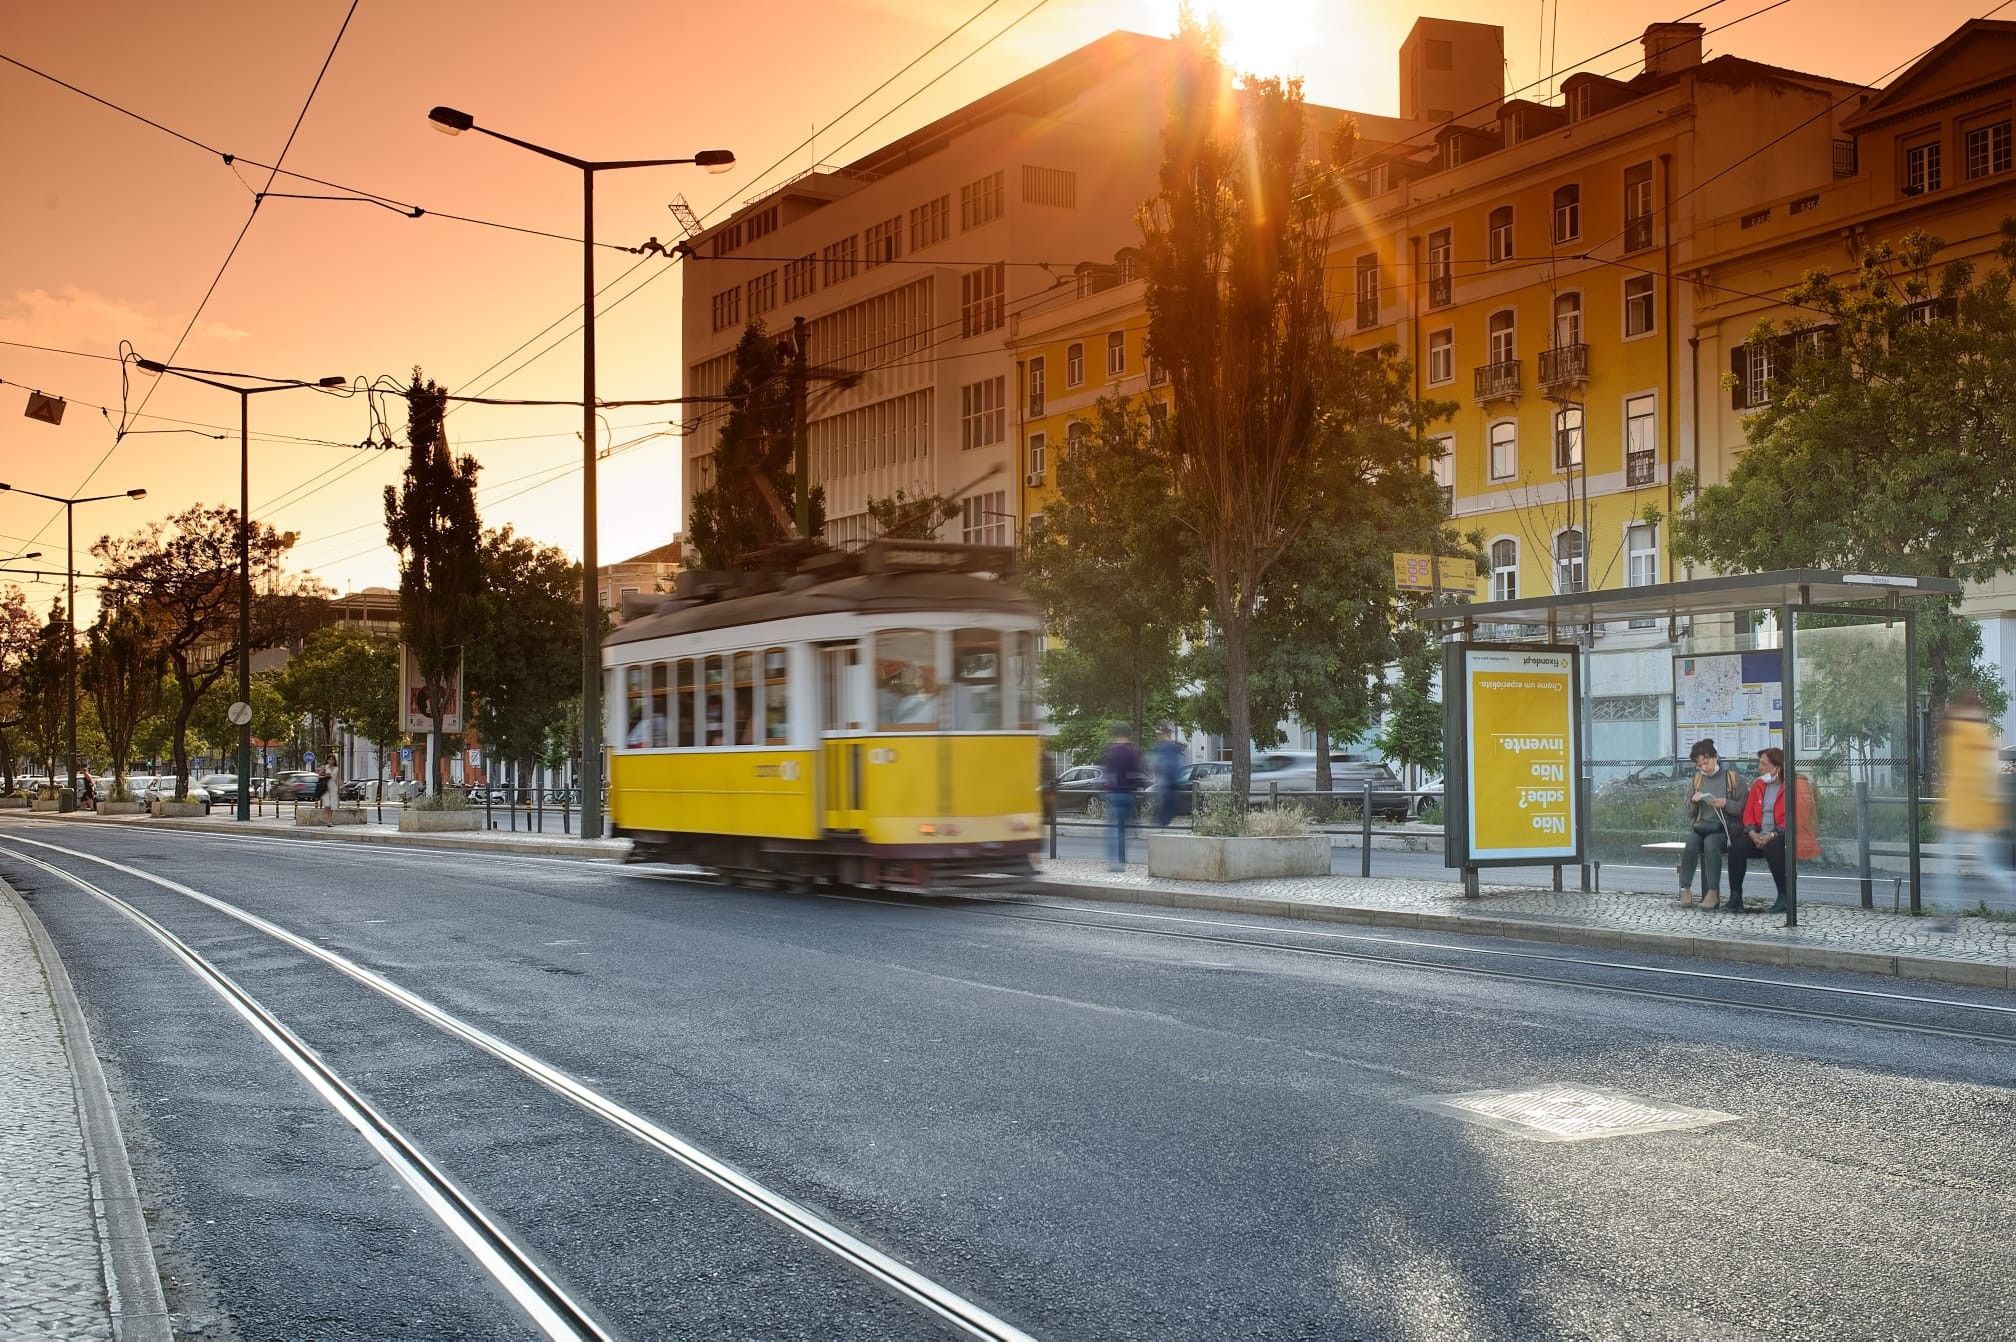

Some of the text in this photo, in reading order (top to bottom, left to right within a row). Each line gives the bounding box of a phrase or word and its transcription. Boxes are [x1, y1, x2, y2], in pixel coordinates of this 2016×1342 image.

[1523, 656, 1559, 667] fixando.pt
[1480, 680, 1523, 691] especialista.
[1537, 682, 1562, 691] Chame
[1499, 738, 1564, 755] invente.
[1531, 764, 1564, 781] Não
[1519, 790, 1565, 808] sabe?
[1532, 816, 1565, 833] Não
